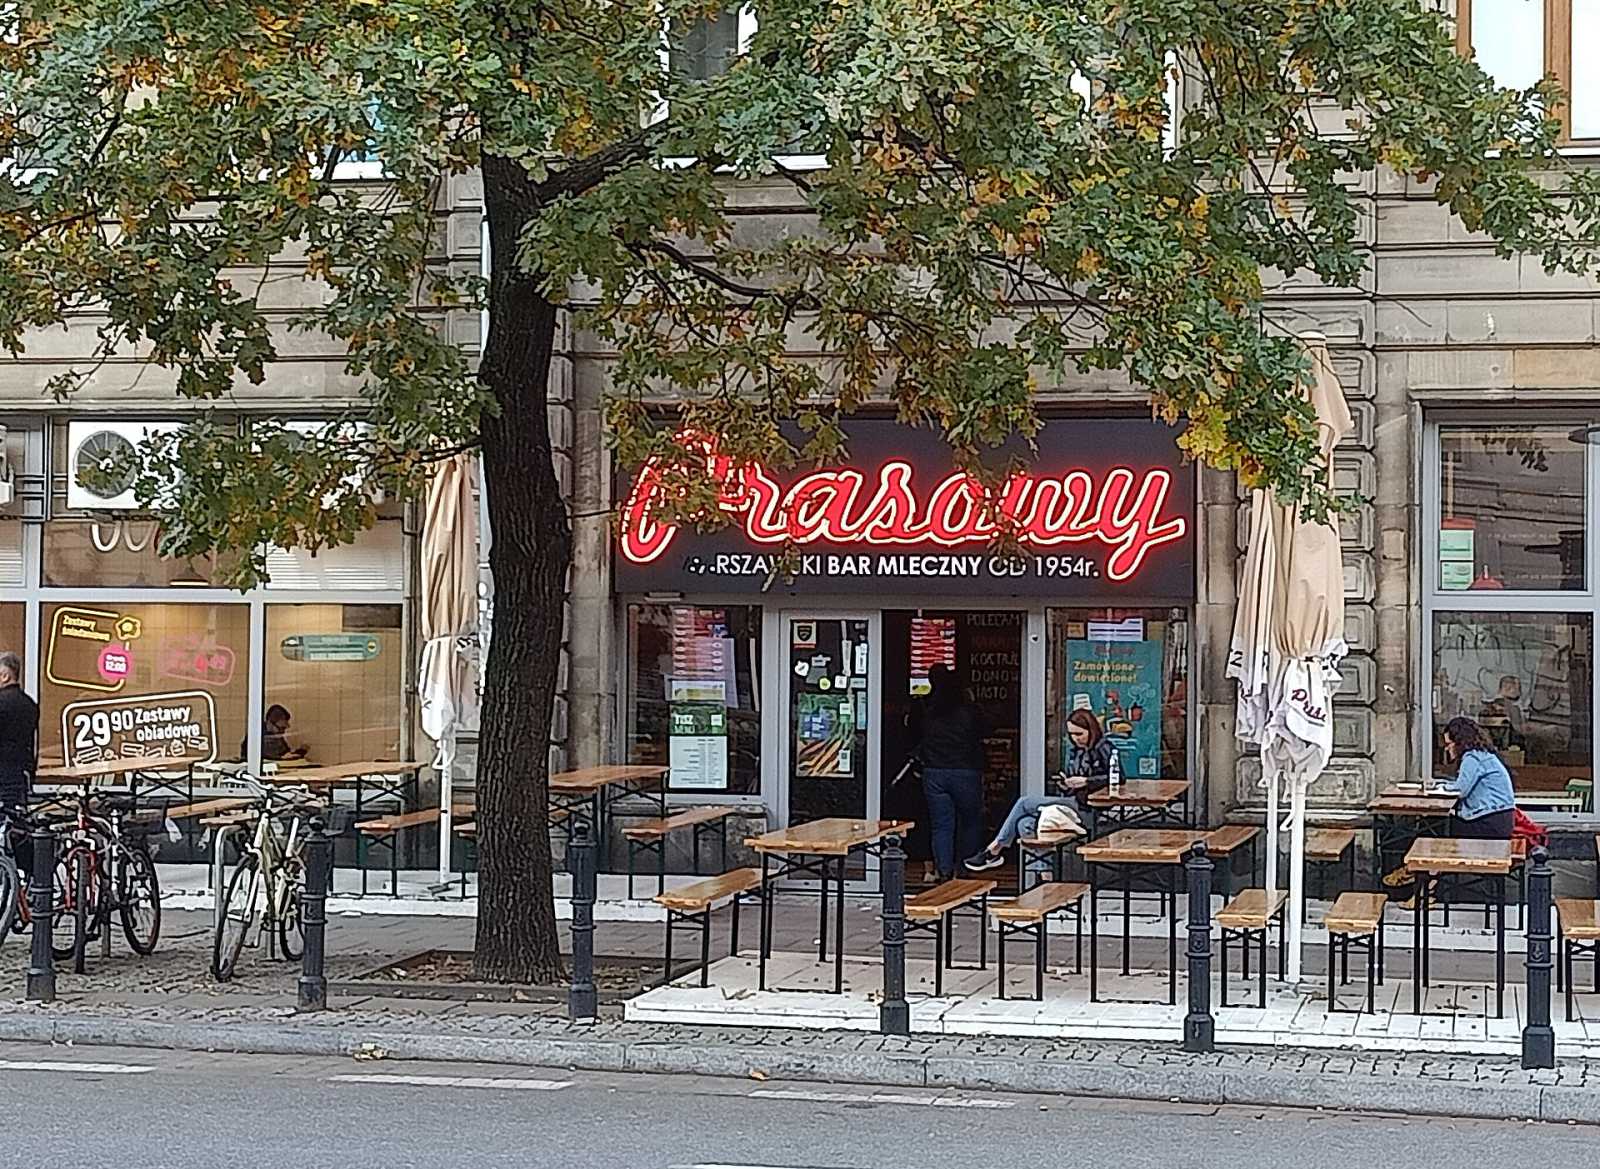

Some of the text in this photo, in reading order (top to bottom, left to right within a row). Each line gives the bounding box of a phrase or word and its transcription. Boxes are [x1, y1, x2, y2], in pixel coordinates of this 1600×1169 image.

[828, 555, 871, 575] BAR
[877, 556, 982, 576] MLECZNY
[1034, 556, 1100, 577] 1954r.
[73, 706, 191, 749] 29 90 Zestawy
[136, 722, 201, 742] obiadowe
